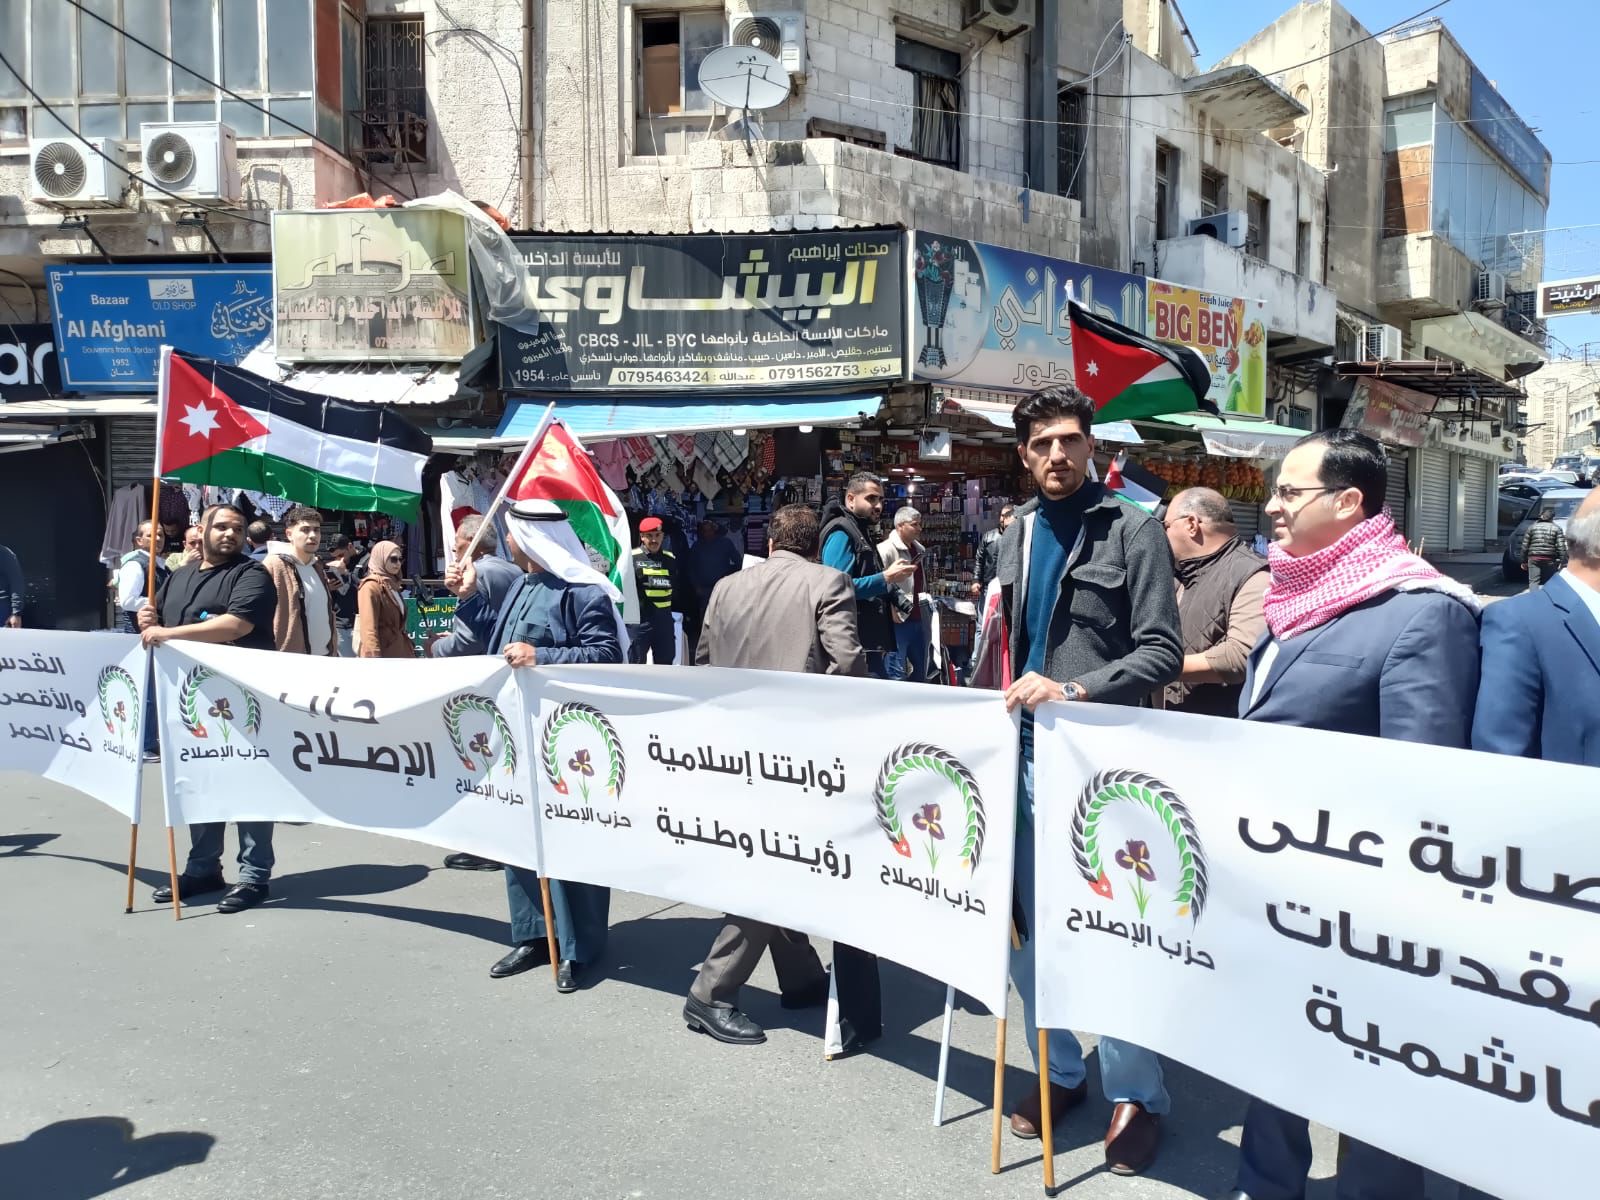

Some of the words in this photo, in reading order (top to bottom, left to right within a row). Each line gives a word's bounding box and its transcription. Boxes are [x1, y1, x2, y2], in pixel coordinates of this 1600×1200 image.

[573, 248, 621, 268] للألبسة
[788, 244, 841, 262] إبراهيم
[845, 243, 889, 257] محلات
[524, 249, 878, 325] البيشاوي
[90, 294, 129, 305] Bazaar
[152, 301, 171, 311] OLD
[172, 301, 197, 311] SHOP
[1199, 293, 1217, 306] Fresh
[66, 319, 87, 338] Al
[91, 319, 166, 342] Afghani
[801, 327, 843, 343] الألبسة
[844, 325, 888, 339] ماركات
[1155, 300, 1192, 343] BIG
[1197, 308, 1238, 351] BEN
[578, 333, 619, 348] CBCS
[632, 333, 654, 348] JIL
[666, 333, 697, 348] BYC
[701, 330, 748, 347] بأنواعها
[752, 329, 799, 347] الداخلية
[115, 346, 132, 354] from
[133, 345, 157, 354] Jordan
[112, 359, 130, 367] 1952
[768, 364, 860, 381] 0791562753
[515, 370, 545, 382] 1954
[618, 370, 709, 383] 0795463424
[1013, 362, 1077, 386] طور
[59, 727, 92, 752] خط
[180, 745, 234, 762] الإصلاح
[237, 746, 270, 762] حزب
[292, 731, 437, 787] الإصلاح
[648, 733, 754, 786] إسلامية
[759, 750, 846, 798] ثوابتنا
[456, 777, 495, 801] الإصلاح
[496, 788, 524, 806] حزب
[545, 802, 594, 825] الإصلاح
[597, 810, 632, 828] حزب
[656, 805, 755, 858] وطنية
[1237, 809, 1385, 868] على
[759, 828, 852, 880] رؤيتنا
[880, 864, 940, 900] الإصلاح
[943, 886, 987, 915] حزب
[1066, 908, 1153, 949] الإصلاح
[1158, 934, 1216, 971] حزب
[1265, 901, 1600, 1030] قدسات
[1305, 984, 1600, 1131] اشمية
